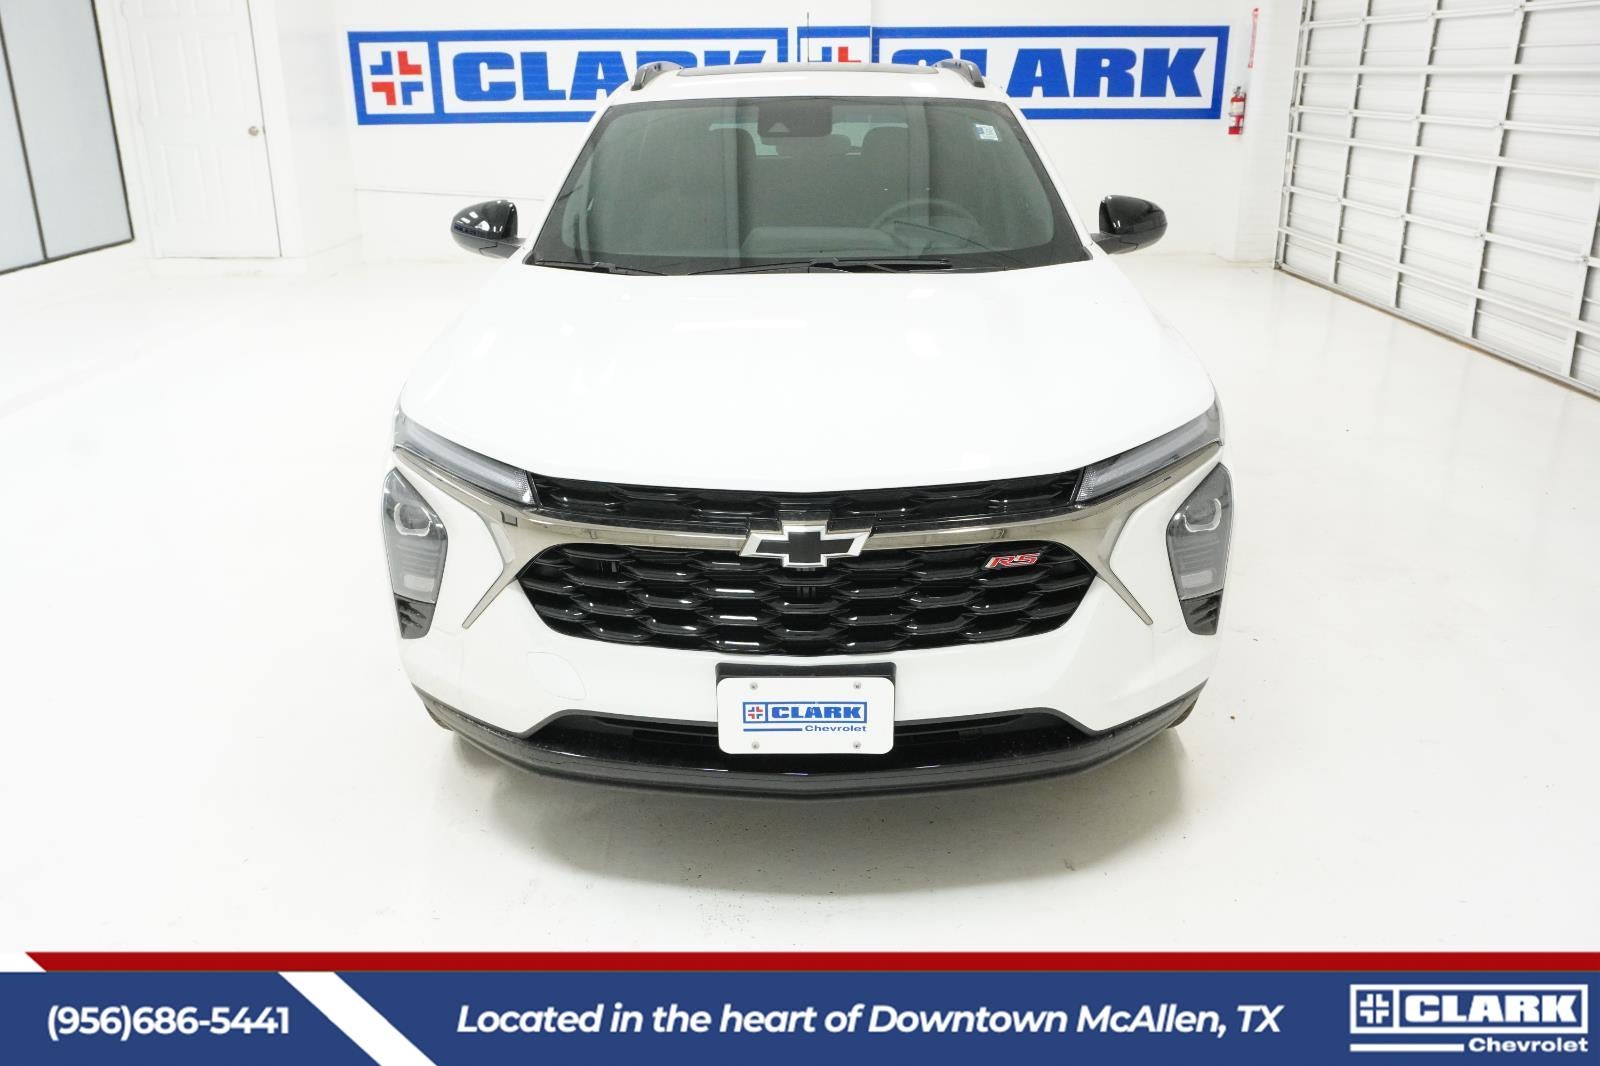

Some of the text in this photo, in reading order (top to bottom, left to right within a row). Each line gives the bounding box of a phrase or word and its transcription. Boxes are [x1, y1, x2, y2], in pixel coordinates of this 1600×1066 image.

[452, 49, 767, 101] CLA
[891, 47, 1207, 98] ARK
[984, 553, 1040, 569] RS
[771, 706, 862, 719] CLARK
[804, 724, 867, 733] Chevrolet
